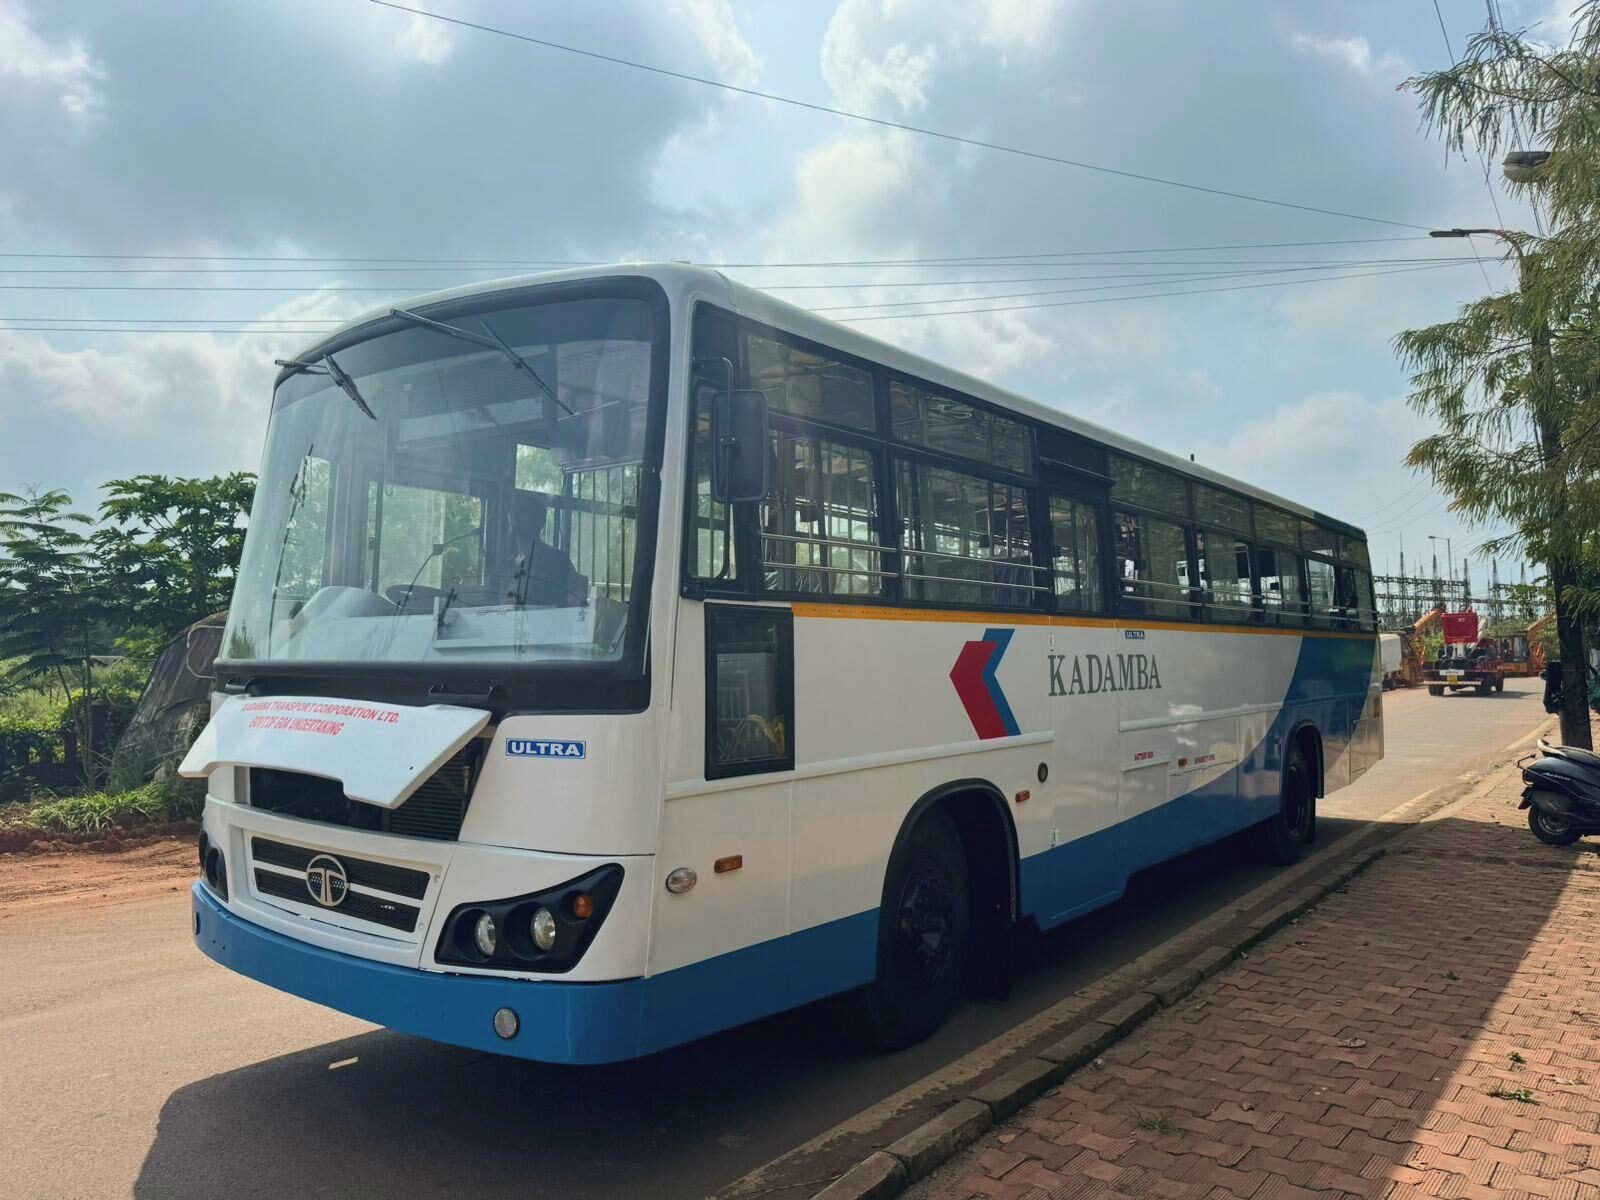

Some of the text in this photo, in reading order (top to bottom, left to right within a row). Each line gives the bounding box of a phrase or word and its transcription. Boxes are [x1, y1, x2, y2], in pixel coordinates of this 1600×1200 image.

[1126, 630, 1144, 639] ULTRA
[1048, 654, 1162, 697] KADAMBA
[270, 702, 317, 714] TRANSPORT
[314, 704, 379, 719] CORPORATION
[378, 711, 400, 724] LTD.
[288, 718, 344, 736] UNDERTAKING
[511, 741, 580, 757] ULTRA
